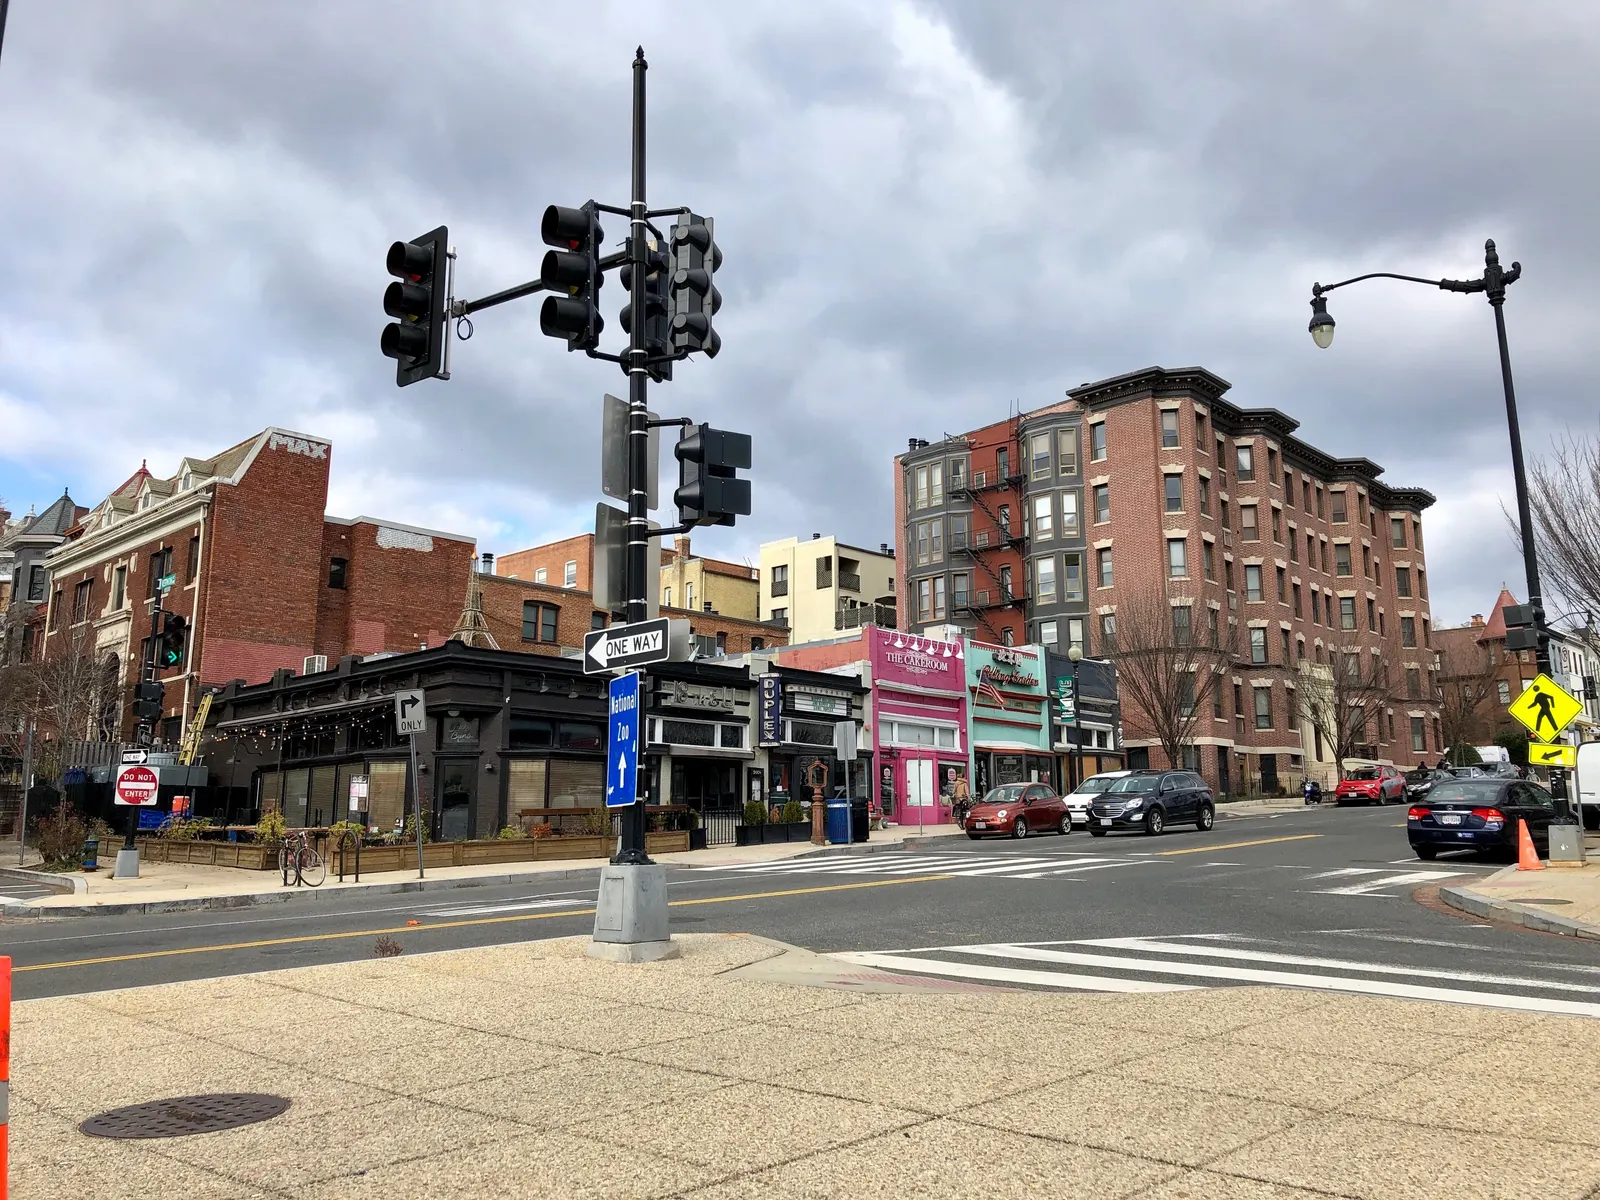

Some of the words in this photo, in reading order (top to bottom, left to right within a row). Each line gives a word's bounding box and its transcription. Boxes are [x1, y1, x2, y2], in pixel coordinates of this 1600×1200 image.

[606, 639, 628, 656] ONE
[633, 633, 659, 651] WAY
[886, 652, 903, 664] THE
[904, 655, 948, 671] CAKEROOM
[611, 689, 637, 715] National
[763, 679, 775, 740] DUPLEX
[401, 720, 422, 731] ONLY
[617, 722, 629, 741] Zoo
[125, 790, 148, 798] ENTER
